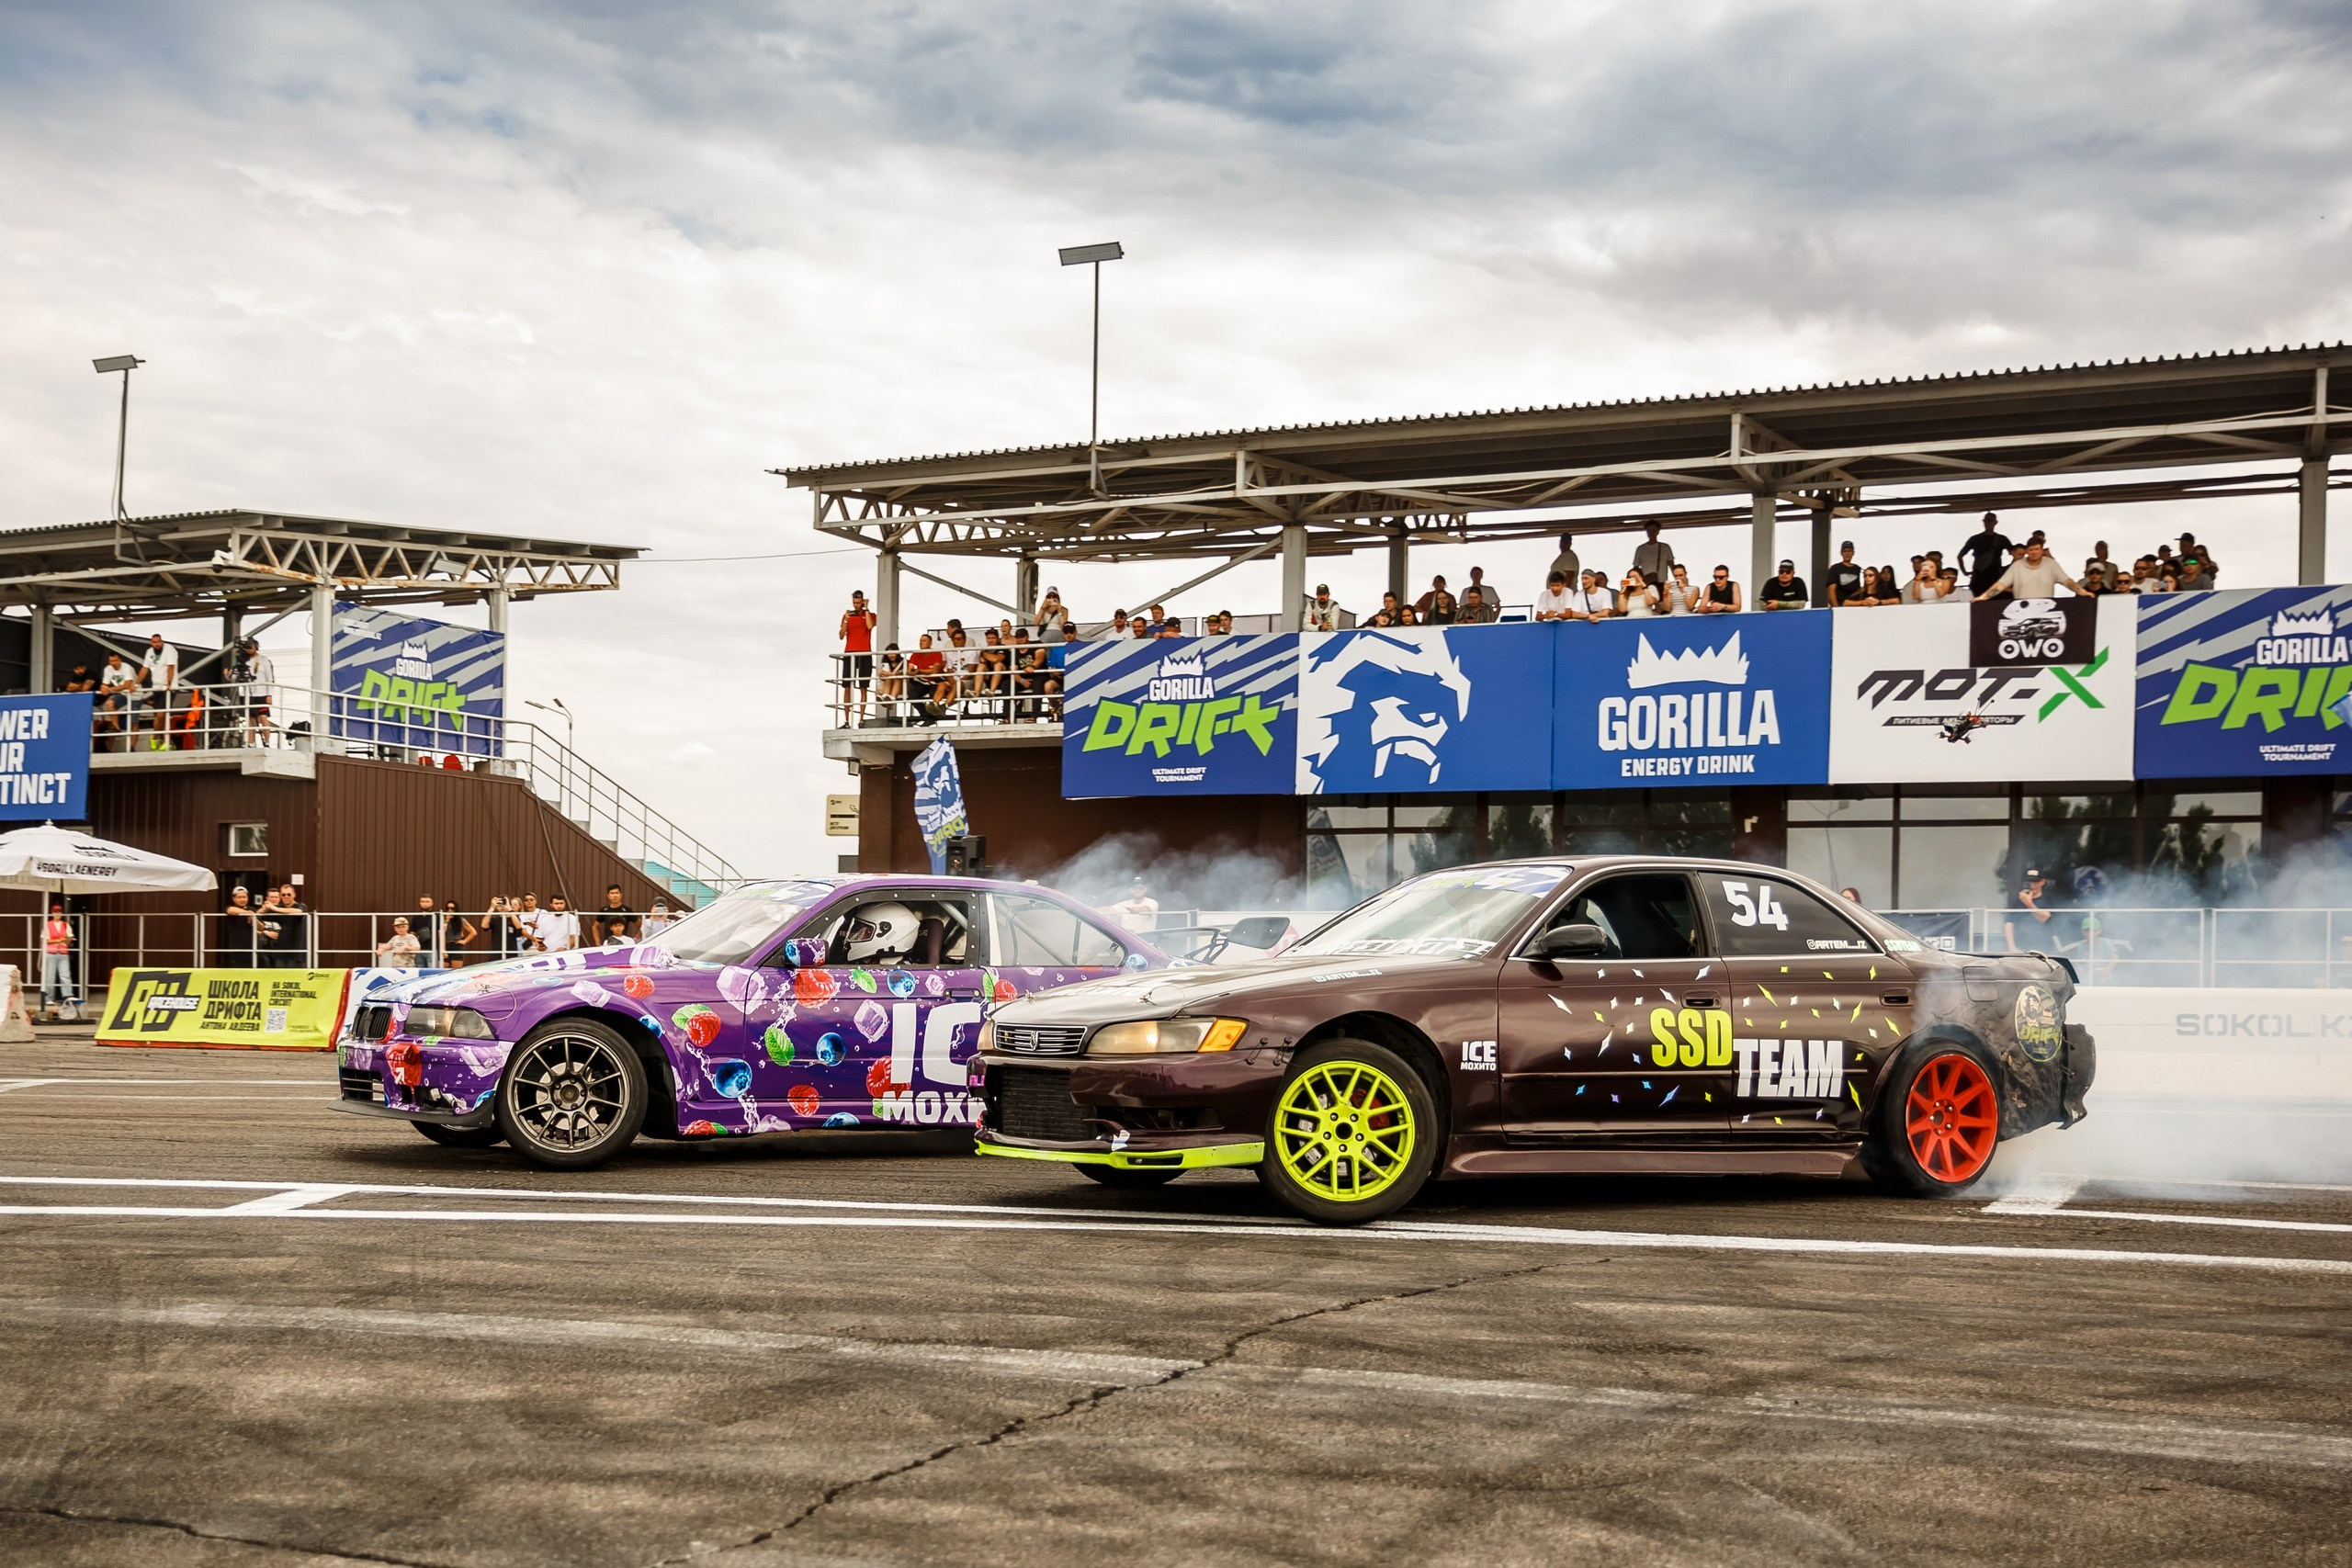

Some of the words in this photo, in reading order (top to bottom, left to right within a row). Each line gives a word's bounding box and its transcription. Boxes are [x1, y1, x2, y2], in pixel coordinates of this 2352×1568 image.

[1997, 637, 2065, 660] OWO
[2256, 636, 2348, 665] GORILLA
[396, 658, 434, 681] GORILLA
[1149, 677, 1215, 702] GORILLA
[1598, 689, 1781, 751] GORILLA
[1892, 716, 1940, 726] ЛИТИЕВЫЕ
[2259, 745, 2305, 753] ULTIMATE
[2307, 743, 2336, 752] DRIFT
[2263, 752, 2333, 761] TOURNAMENT
[1152, 768, 1185, 776] ULTIMATE
[1185, 767, 1207, 775] DRIFT
[1621, 757, 1694, 777] ENERGY
[1697, 754, 1756, 774] DRINK
[1155, 774, 1204, 783] TOURNAMENT
[1722, 880, 1789, 931] 54
[208, 980, 259, 999] ШКОЛА
[270, 989, 318, 999] INTERNATIONAL
[203, 1000, 261, 1021] ДРИФТА
[1649, 1008, 1733, 1067] SSD
[1462, 1040, 1497, 1063] ICE
[1460, 1061, 1497, 1071] МОХИТО
[1733, 1039, 1843, 1098] TEAM
